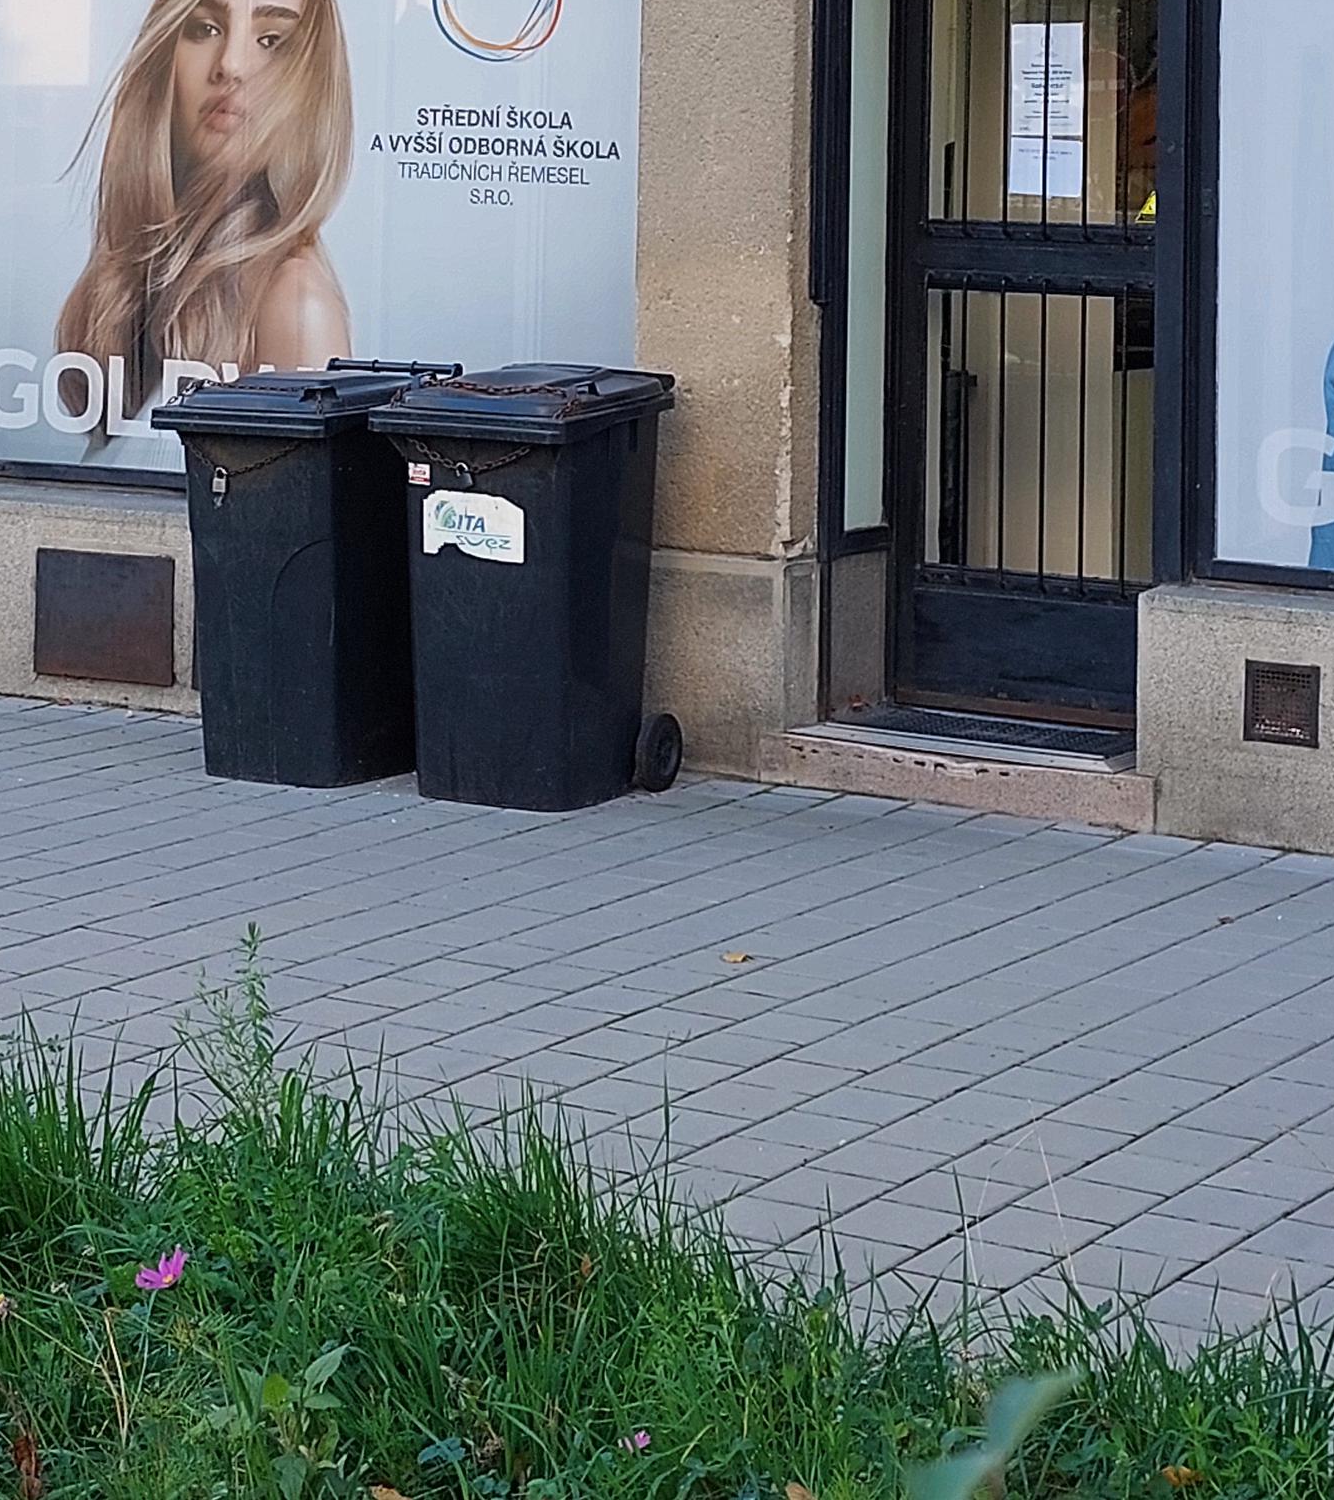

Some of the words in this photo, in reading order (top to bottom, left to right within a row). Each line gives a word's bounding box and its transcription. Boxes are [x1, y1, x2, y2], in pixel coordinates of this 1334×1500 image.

[416, 103, 502, 129] STŘEDNÍ
[505, 105, 573, 131] ŠKOLA
[369, 134, 384, 152] A
[388, 131, 444, 155] VYŠŠÍ
[448, 135, 548, 158] ODBORNÁ
[552, 135, 621, 161] ŠKOLA
[397, 159, 503, 182] TRADIČNÍCH
[507, 161, 591, 186] ŘEMESEL
[469, 188, 515, 207] S.R.O.
